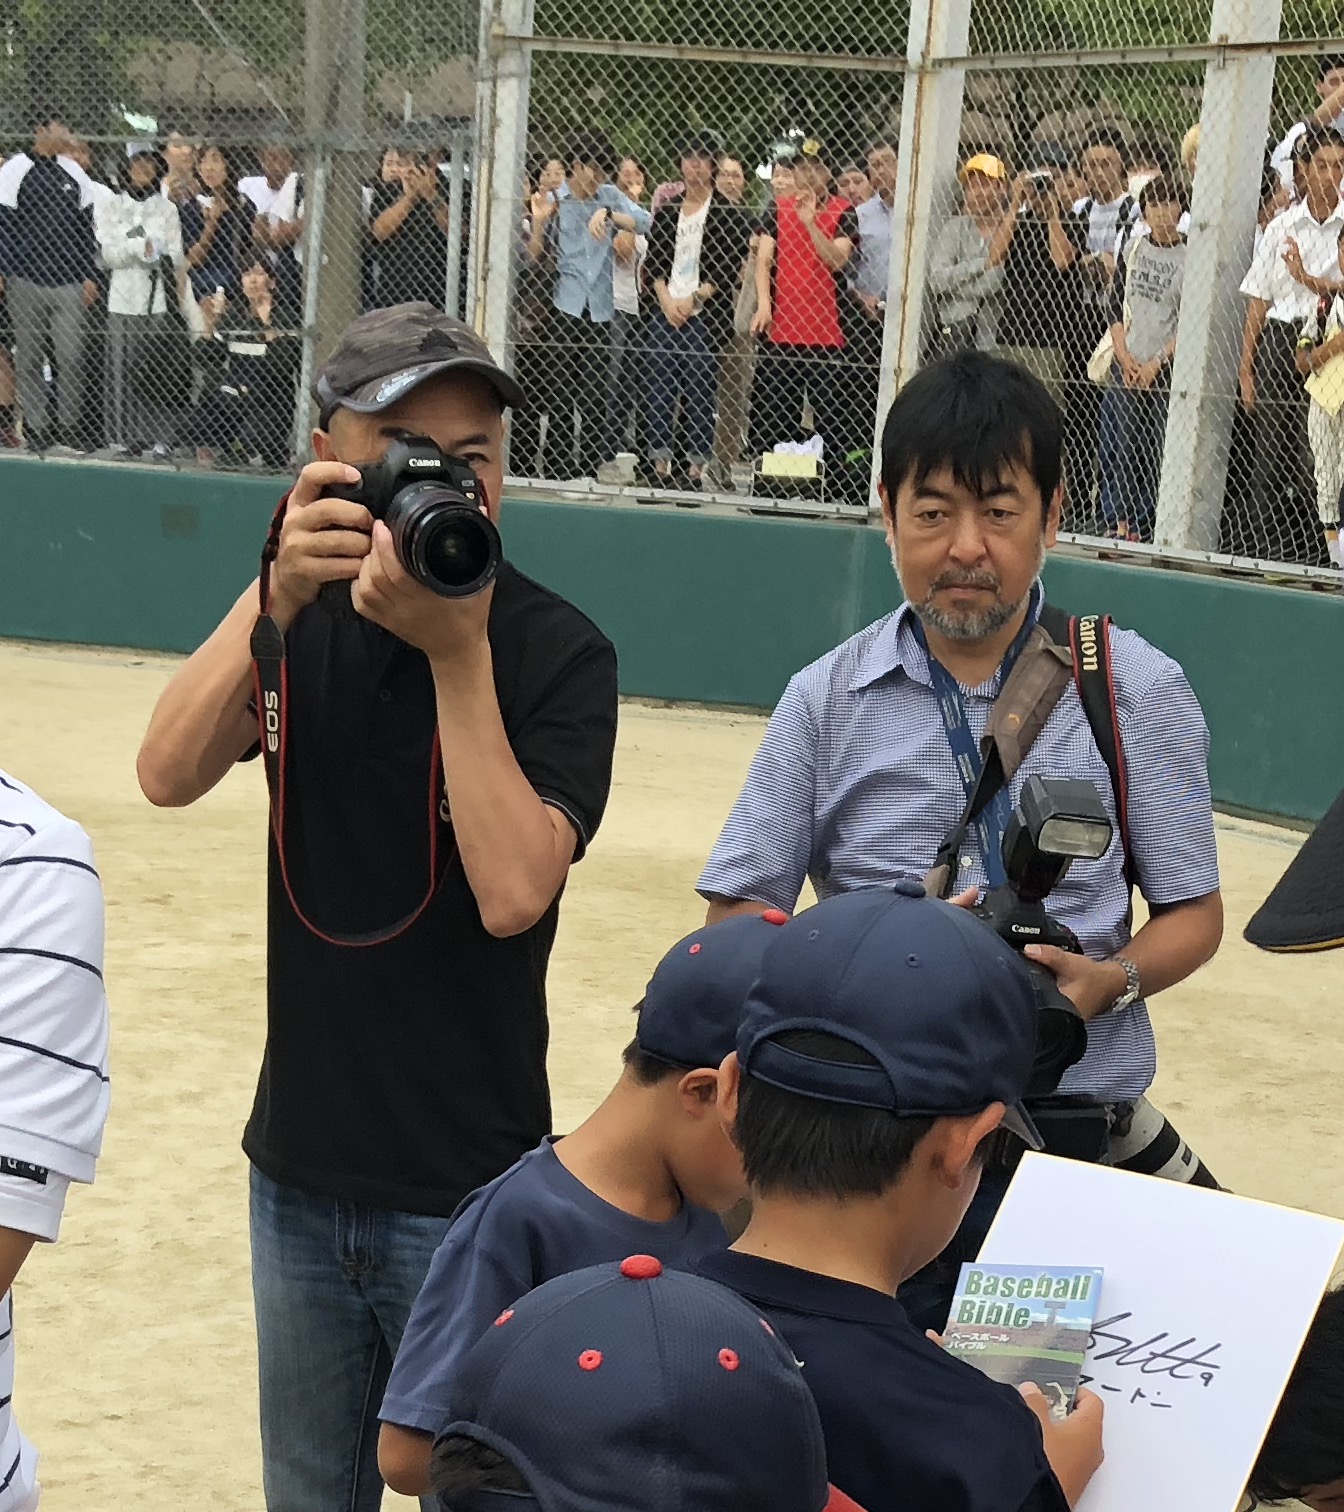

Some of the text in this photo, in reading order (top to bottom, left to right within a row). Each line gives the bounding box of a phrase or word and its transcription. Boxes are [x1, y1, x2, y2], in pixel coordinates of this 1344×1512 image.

[409, 458, 441, 467] Canon
[264, 690, 279, 752] EOS
[1011, 924, 1041, 935] Canon
[964, 1270, 1092, 1301] Baseball
[956, 1299, 1031, 1328] Bible
